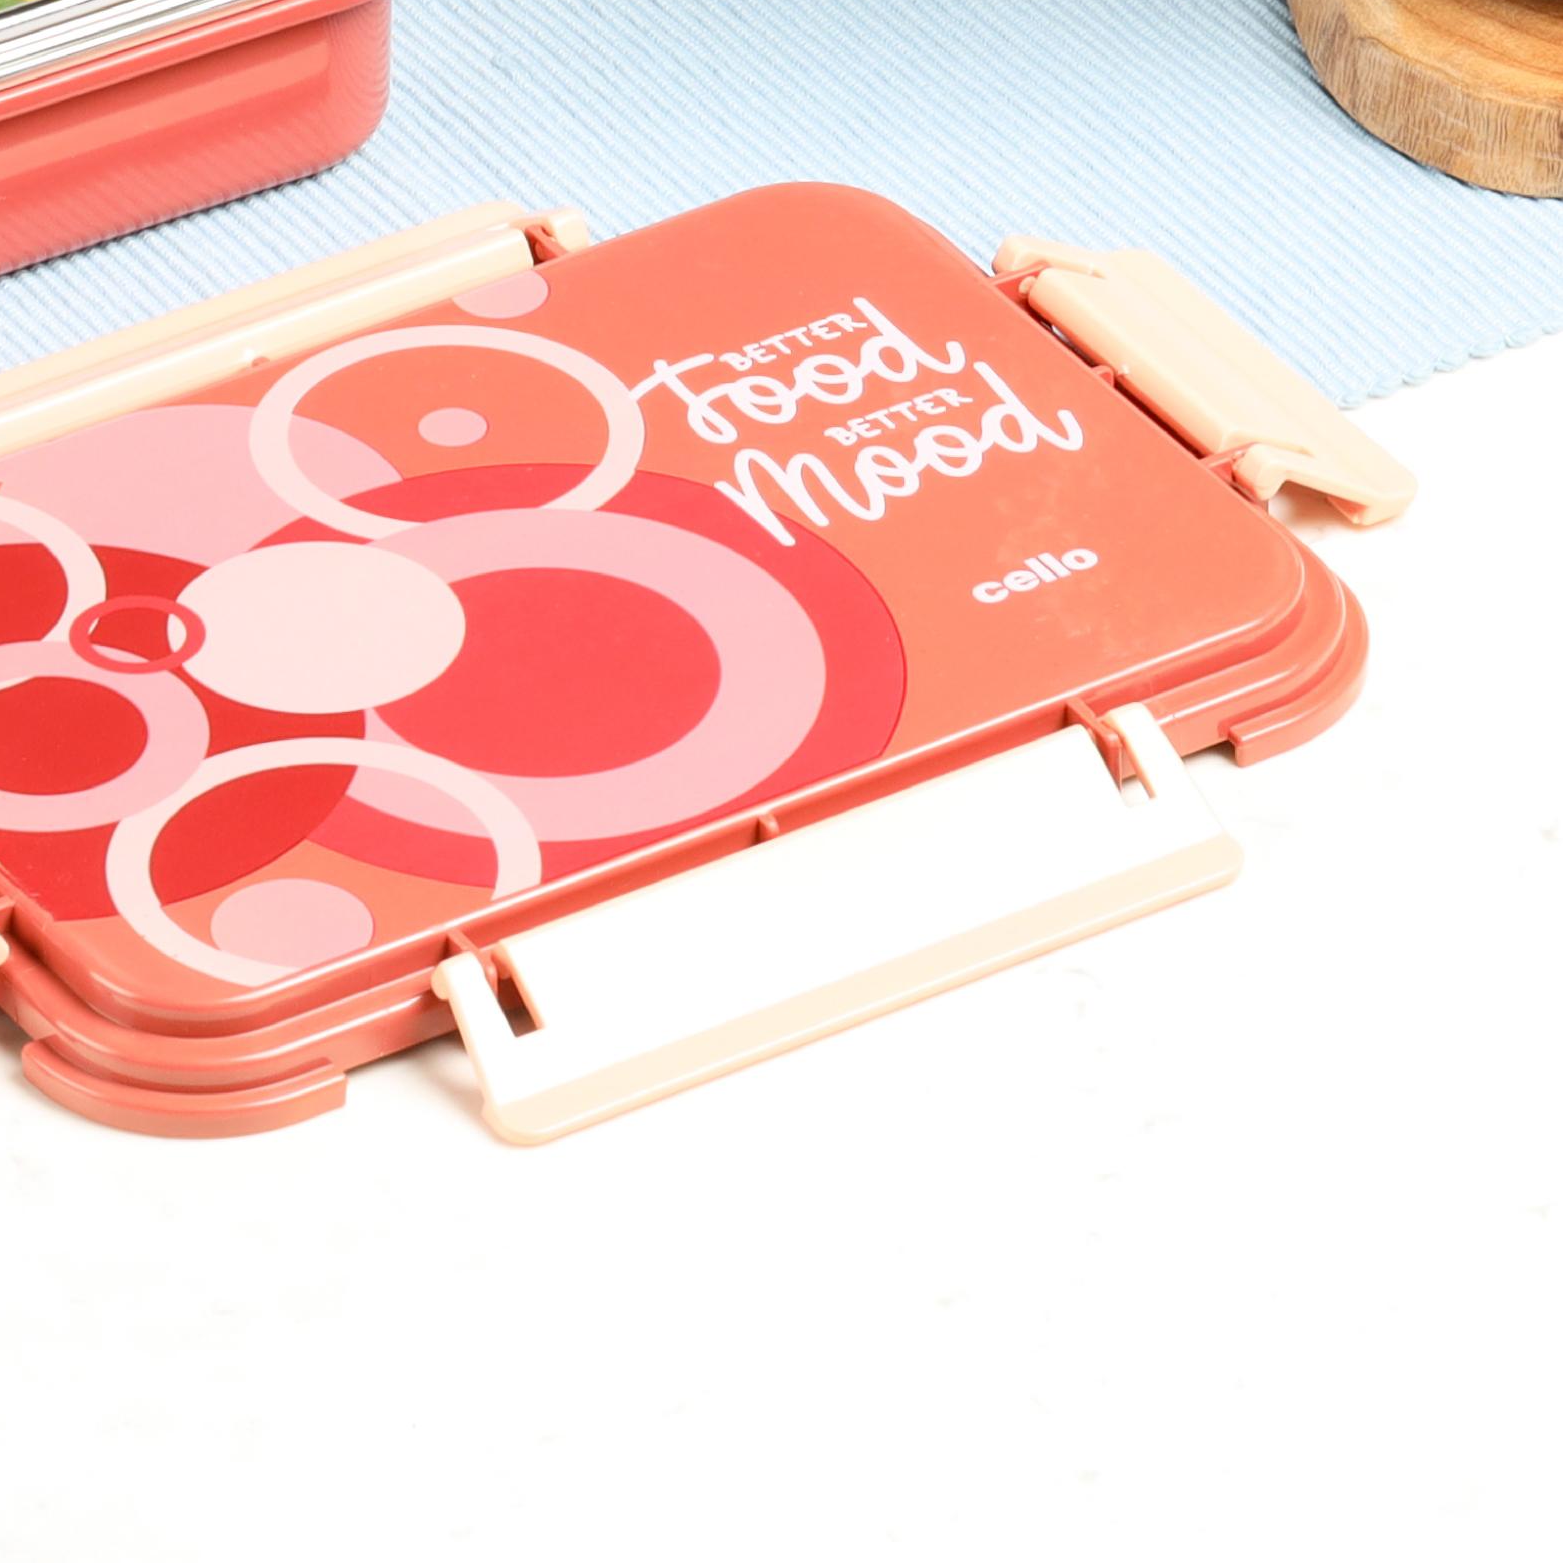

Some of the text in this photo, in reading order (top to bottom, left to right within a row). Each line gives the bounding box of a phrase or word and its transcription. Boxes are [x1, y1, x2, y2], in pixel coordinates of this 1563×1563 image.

[719, 313, 868, 371] BETTER
[823, 387, 974, 446] BETTER
[972, 548, 1099, 604] cello
